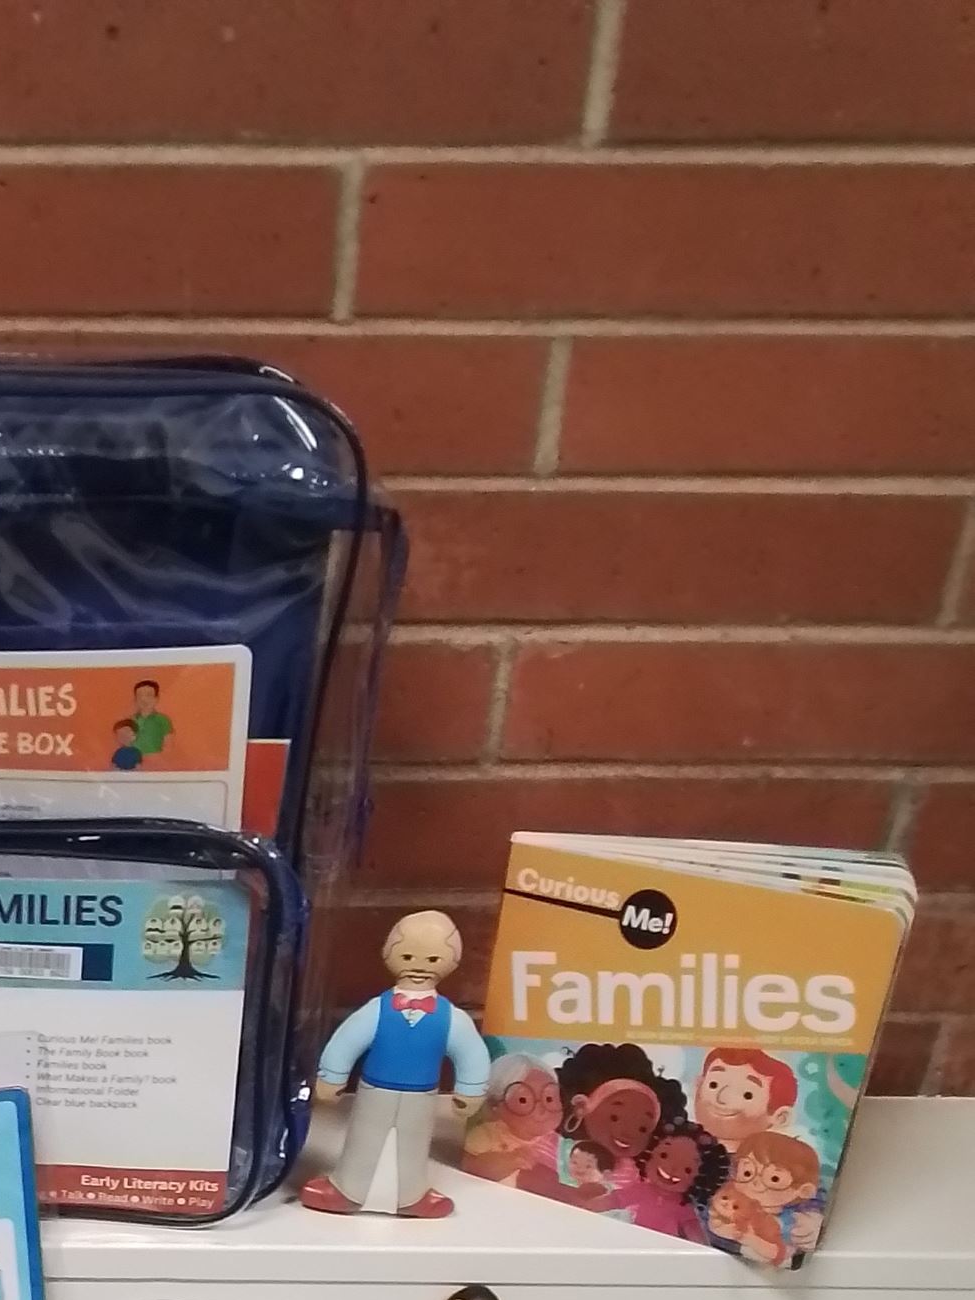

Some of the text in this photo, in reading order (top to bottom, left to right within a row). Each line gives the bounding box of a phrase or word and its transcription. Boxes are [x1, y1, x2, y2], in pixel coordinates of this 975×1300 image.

[16, 732, 75, 756] BOX
[516, 868, 623, 912] Curious
[622, 905, 675, 935] Me!
[511, 950, 857, 1034] Families
[101, 1035, 144, 1045] Families
[146, 1036, 172, 1045] book
[59, 1047, 92, 1058] Family
[37, 1059, 108, 1070] Families book
[37, 1072, 63, 1082] What
[66, 1073, 99, 1083] Makes
[152, 1076, 177, 1085] book
[107, 1086, 140, 1096] Folder
[65, 1098, 86, 1107] blue
[89, 1100, 138, 1110] backpack
[80, 1174, 219, 1193] Early Literacy Kits
[61, 1189, 85, 1200] Talk
[142, 1195, 175, 1206] Write
[189, 1197, 215, 1209] Play
